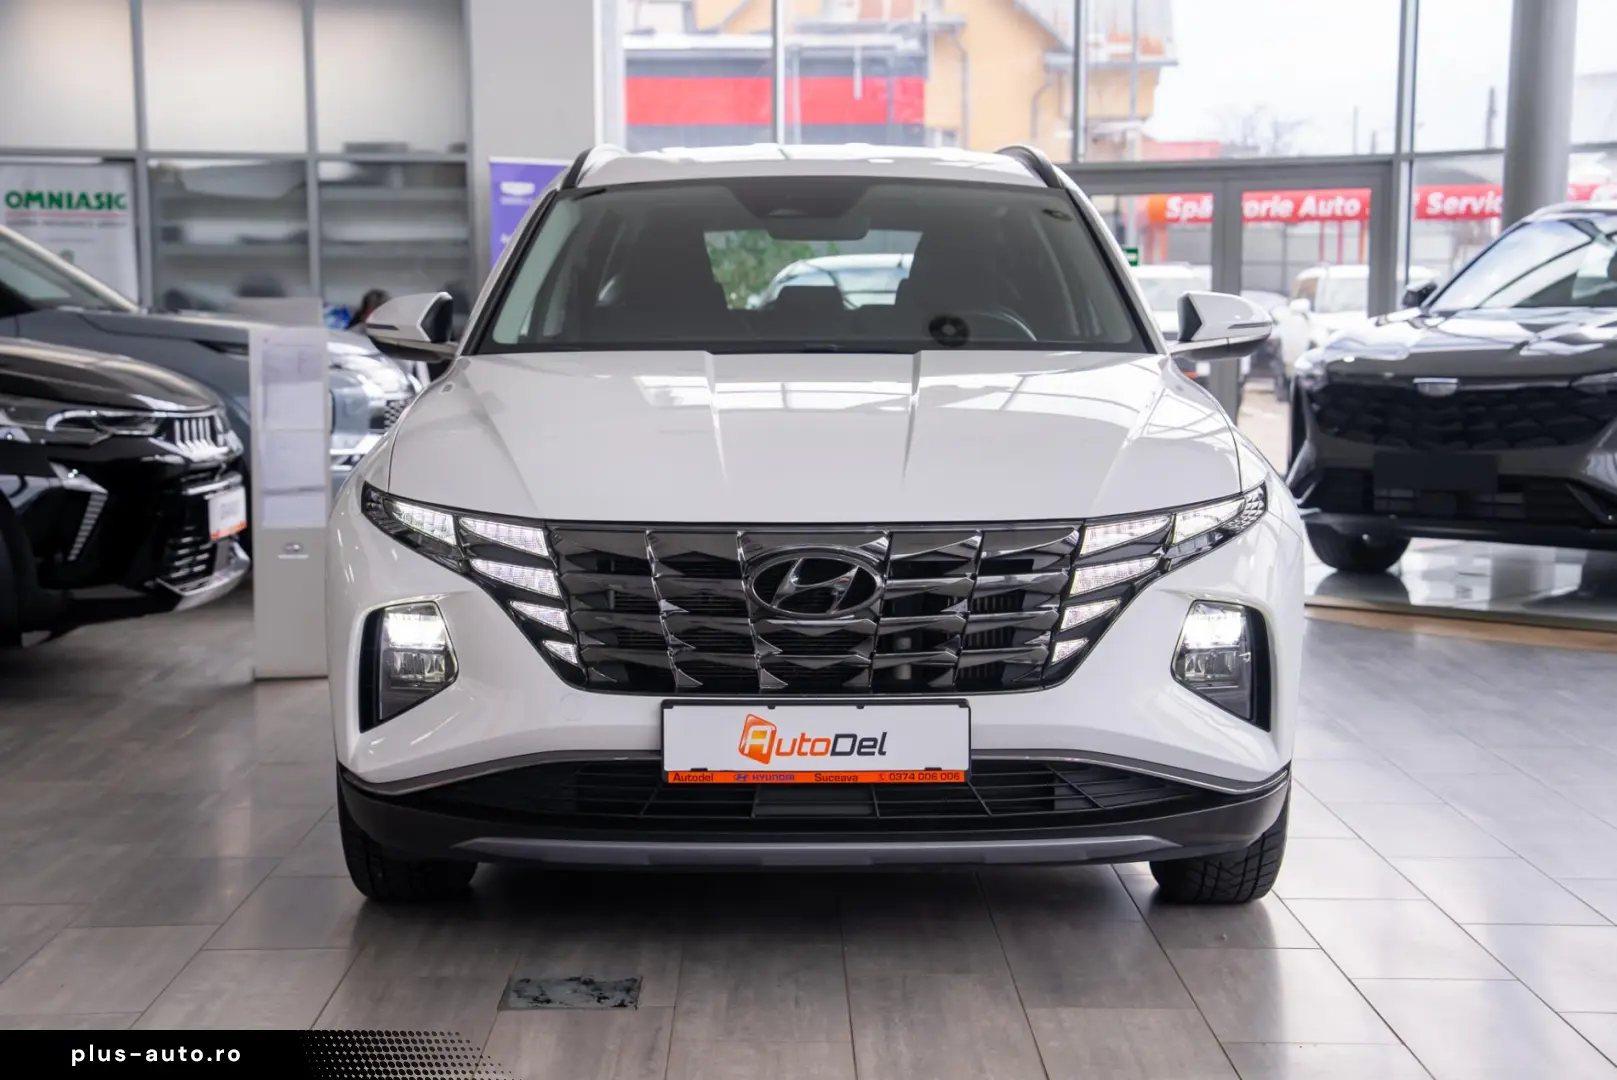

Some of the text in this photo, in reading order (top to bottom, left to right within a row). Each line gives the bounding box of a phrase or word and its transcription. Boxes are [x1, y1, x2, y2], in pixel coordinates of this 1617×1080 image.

[1298, 193, 1361, 216] Auto
[740, 721, 888, 758] AutoDel
[673, 772, 714, 782] Autodel
[814, 773, 859, 782] Suceava
[888, 772, 915, 781] 0374
[918, 772, 938, 781] 006
[940, 772, 960, 781] 006
